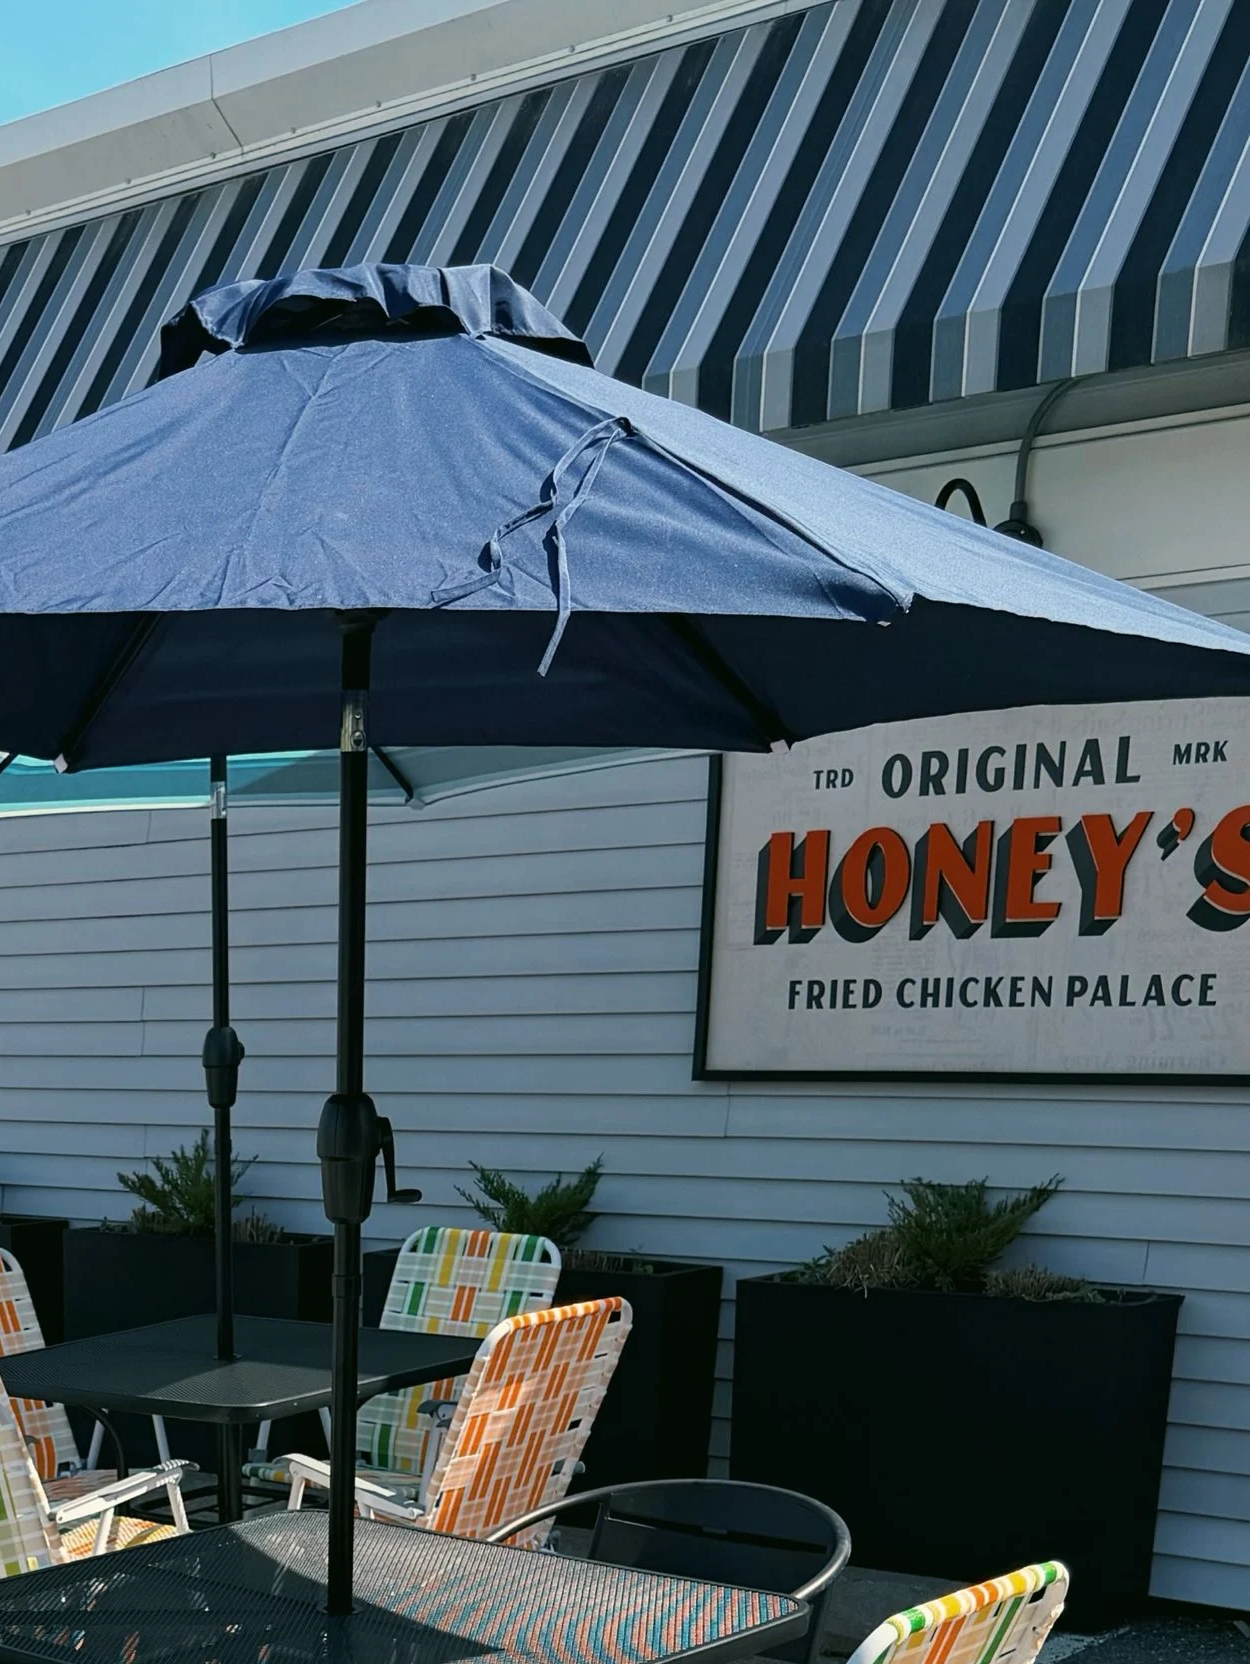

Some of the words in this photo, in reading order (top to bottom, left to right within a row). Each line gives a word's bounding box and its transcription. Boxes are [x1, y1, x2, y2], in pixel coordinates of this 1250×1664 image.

[814, 769, 854, 790] TRD
[882, 736, 1141, 799] ORIGINAL
[1172, 740, 1228, 765] MRK
[753, 805, 1250, 945] HONEY'S
[788, 979, 882, 1010] FRIED
[896, 976, 1053, 1008] CHICKEN
[1067, 974, 1218, 1008] PALACE
